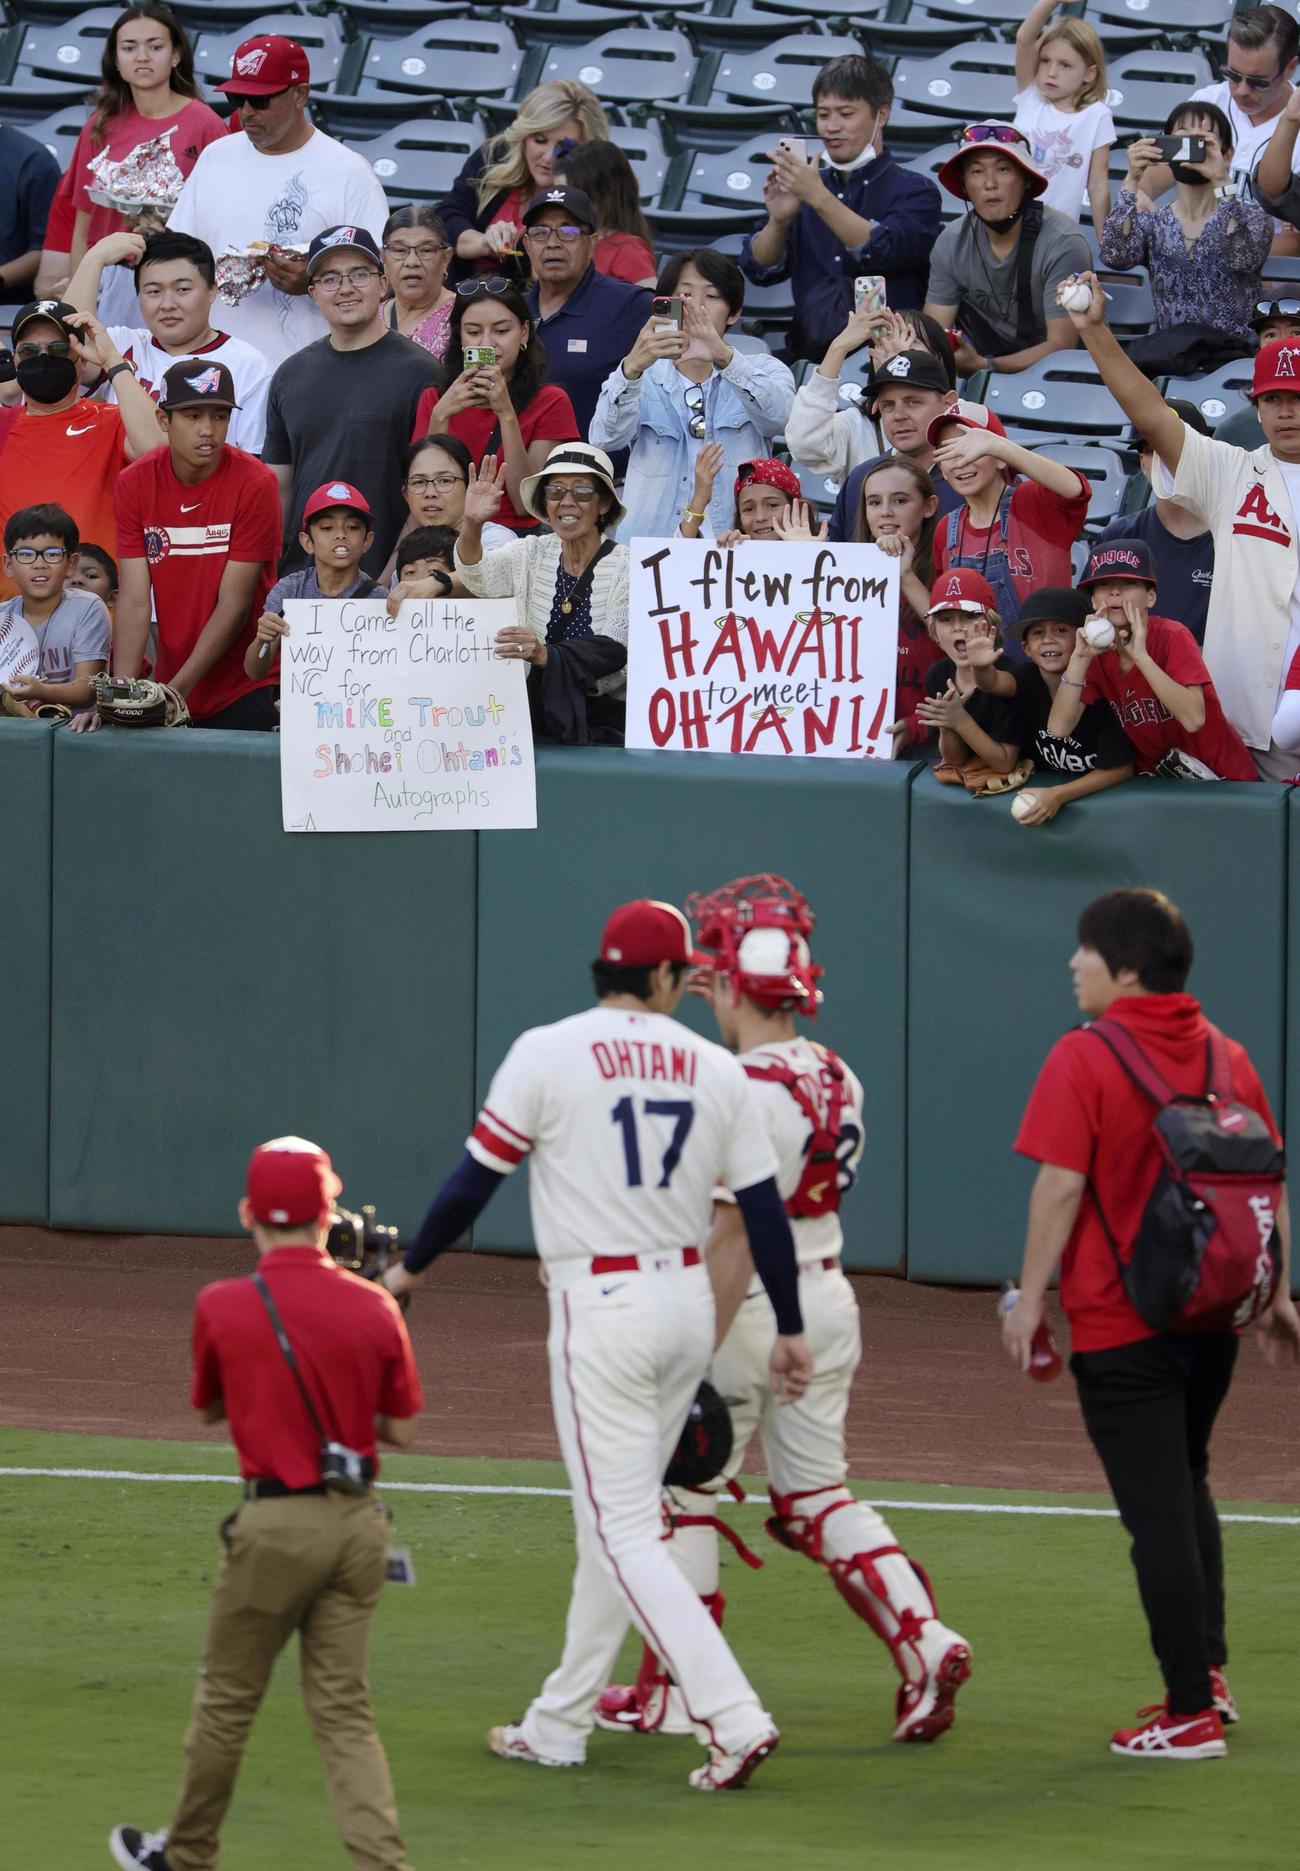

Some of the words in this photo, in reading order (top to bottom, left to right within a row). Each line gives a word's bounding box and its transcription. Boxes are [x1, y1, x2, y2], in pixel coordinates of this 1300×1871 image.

[1275, 347, 1296, 377] A
[1210, 403, 1217, 414] 5
[1090, 549, 1141, 577] Angels
[641, 547, 681, 618] I
[689, 549, 793, 610] flew
[801, 549, 889, 608] from
[946, 576, 962, 596] A
[306, 604, 325, 636] I
[340, 602, 398, 634] Came
[411, 601, 434, 630] all
[442, 603, 476, 632] the
[289, 641, 335, 676] way
[347, 633, 399, 666] from
[657, 606, 865, 684] HAWAII
[291, 672, 324, 698] NC
[338, 668, 372, 699] for
[700, 680, 738, 711] to
[753, 678, 825, 708] meet
[113, 707, 143, 716] A2000
[408, 694, 505, 728] Trout
[647, 687, 889, 755] OHTANI!
[384, 726, 413, 743] and
[313, 741, 403, 778] Shohei
[416, 730, 524, 774] Ohtani's
[373, 780, 490, 820] Autographs
[591, 1039, 698, 1088] OHTANI
[611, 1095, 695, 1189] 17
